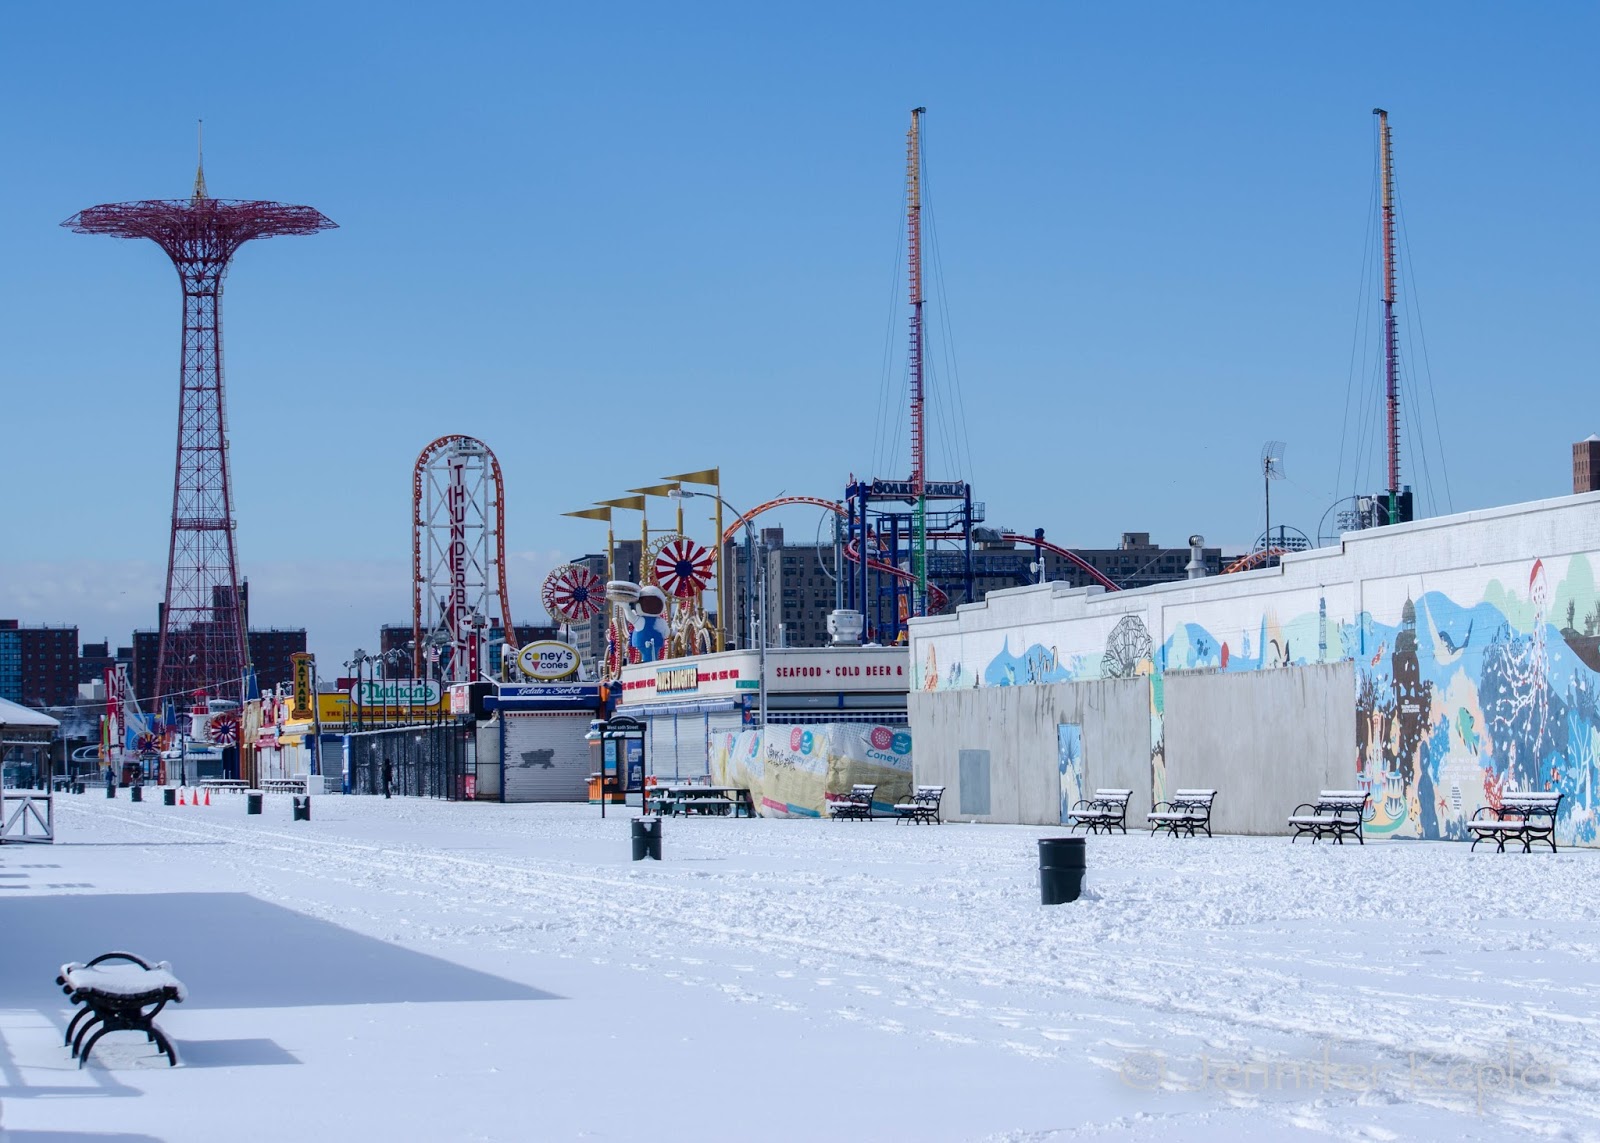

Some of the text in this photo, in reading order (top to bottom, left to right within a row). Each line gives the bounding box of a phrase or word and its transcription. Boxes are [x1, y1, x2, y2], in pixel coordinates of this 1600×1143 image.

[524, 650, 573, 662] coney's
[776, 665, 903, 678] SEAFOOD COLD BEER &
[298, 659, 306, 710] NATHANS
[517, 686, 545, 696] Gelato
[552, 686, 582, 696] Sorbet
[117, 666, 125, 755] THUNDERBOLT
[866, 749, 899, 765] Coney
